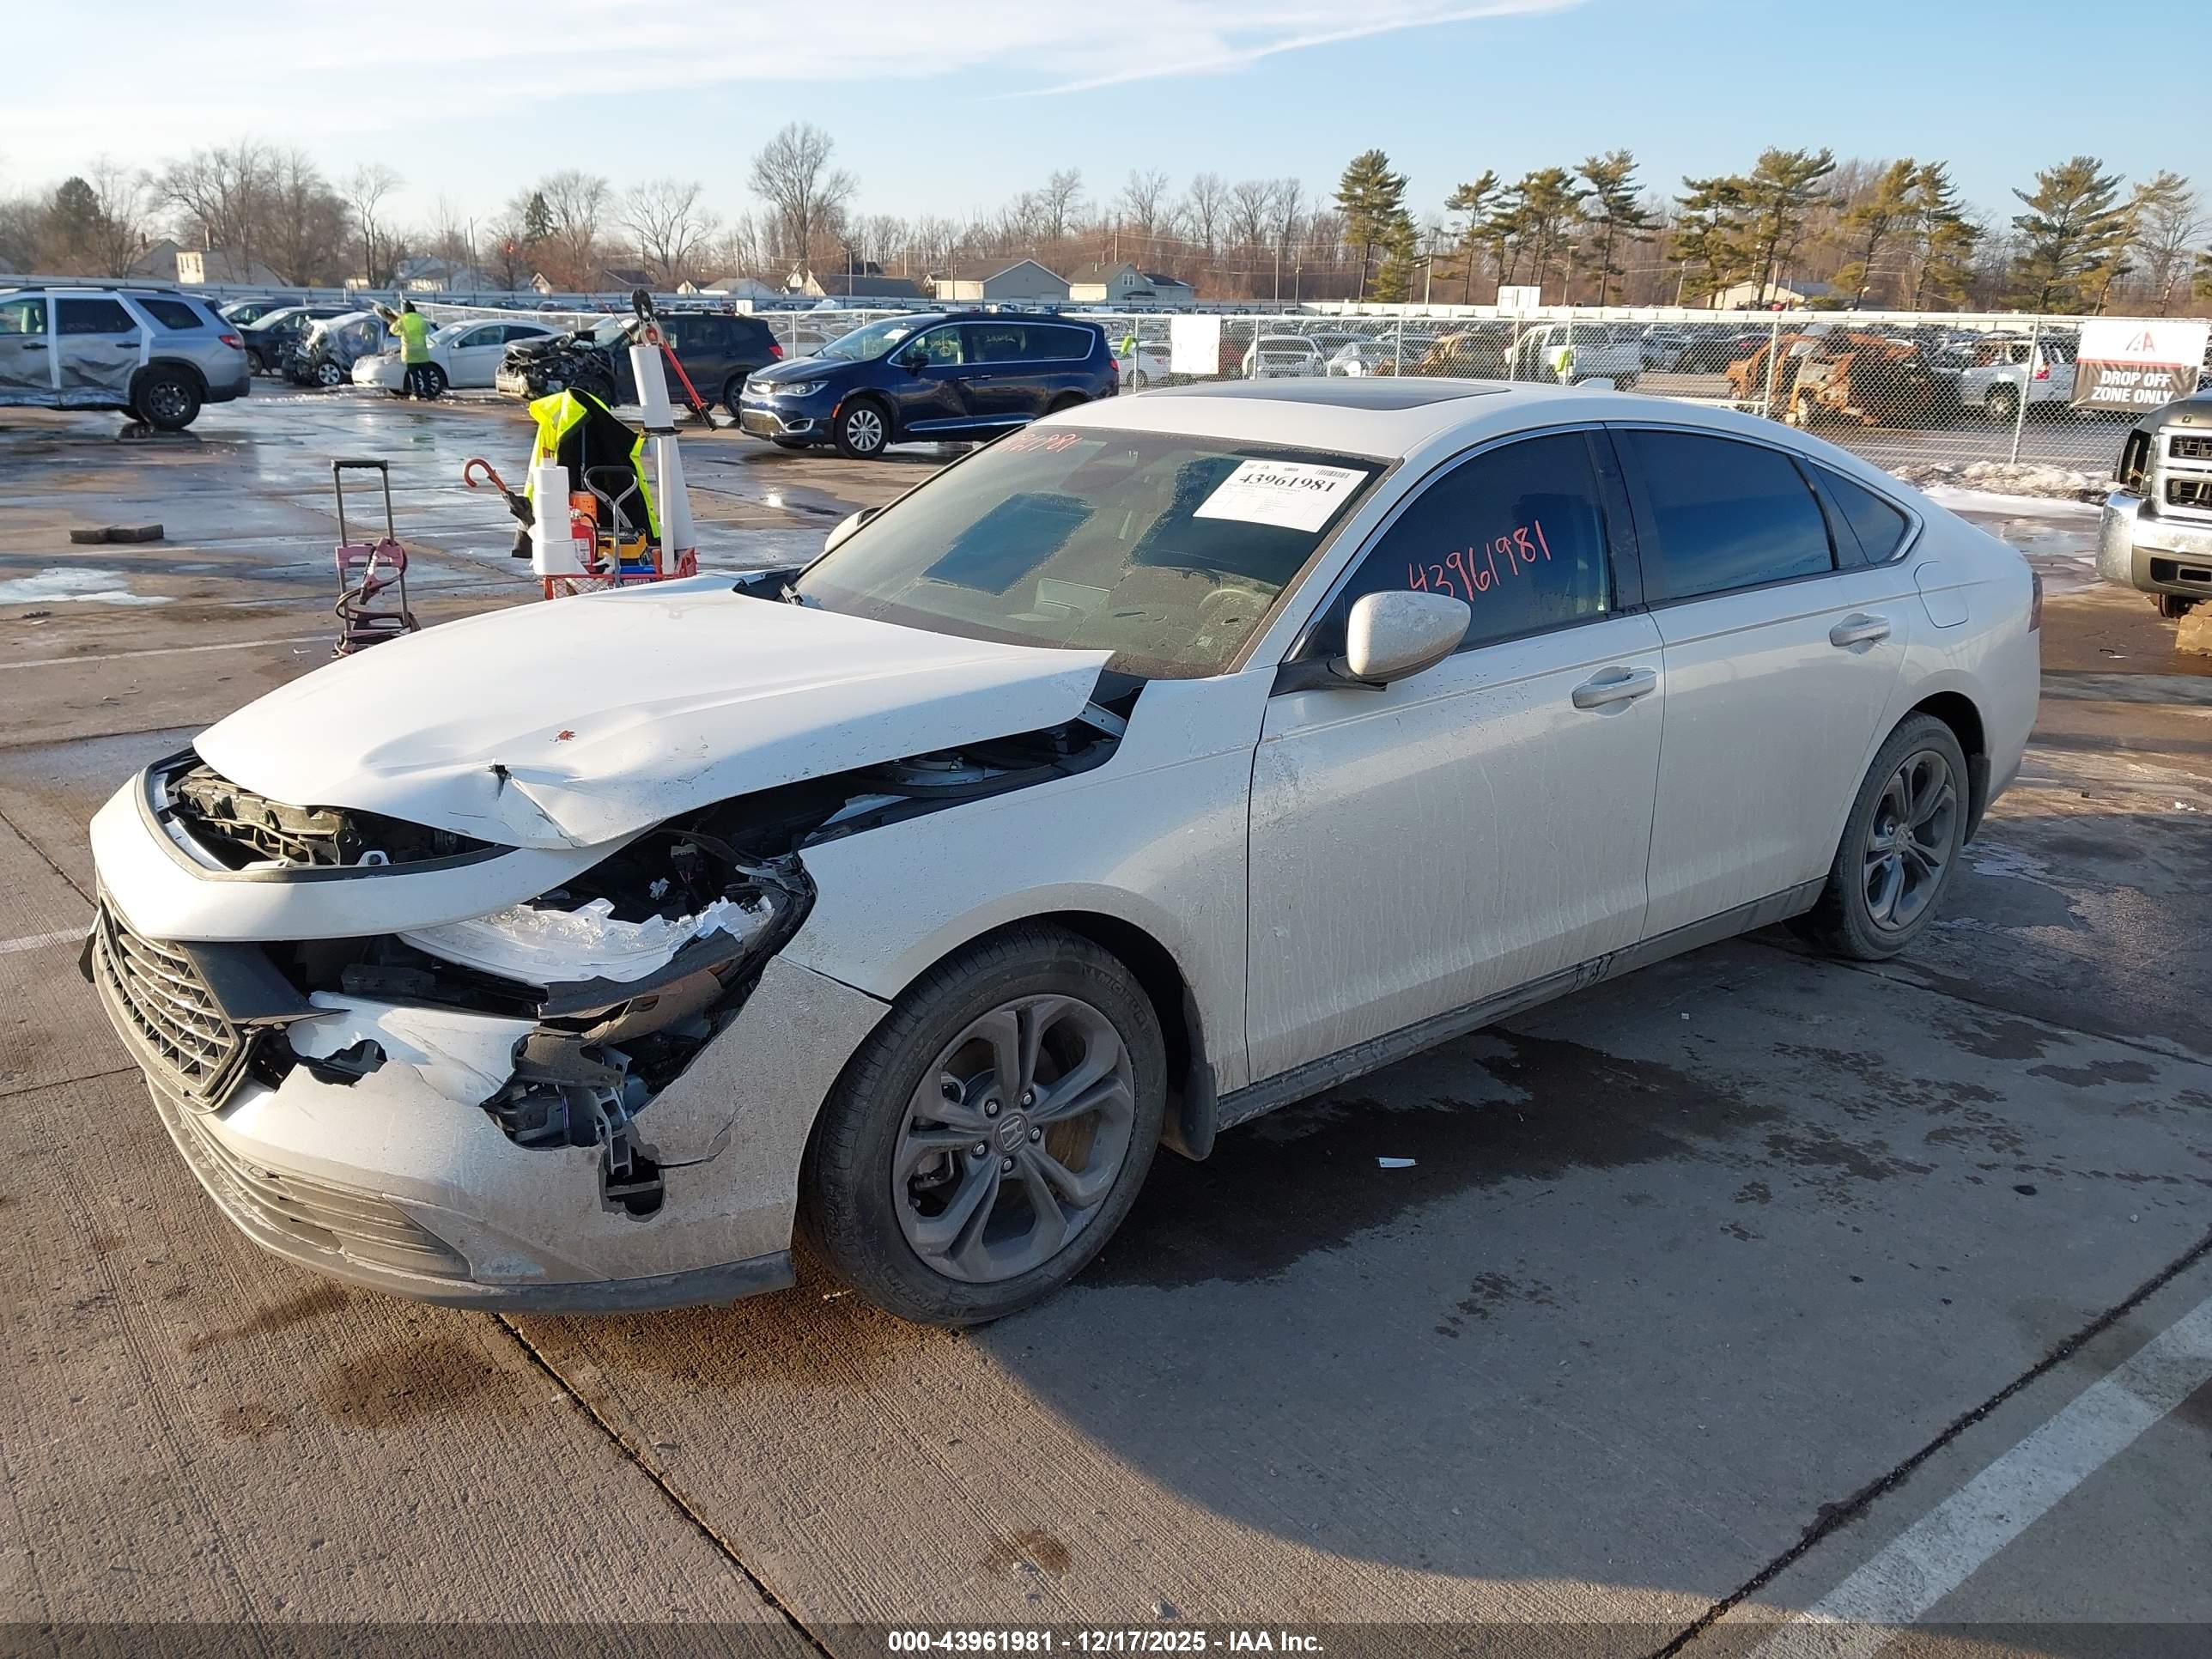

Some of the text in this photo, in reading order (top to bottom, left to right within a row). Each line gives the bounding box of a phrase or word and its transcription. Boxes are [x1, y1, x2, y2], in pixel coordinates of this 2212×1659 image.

[2101, 370, 2172, 387] DROP OFF
[2091, 386, 2174, 404] ZONE ONLY
[1239, 473, 1337, 493] 43961981
[1408, 520, 1552, 601] 43961981
